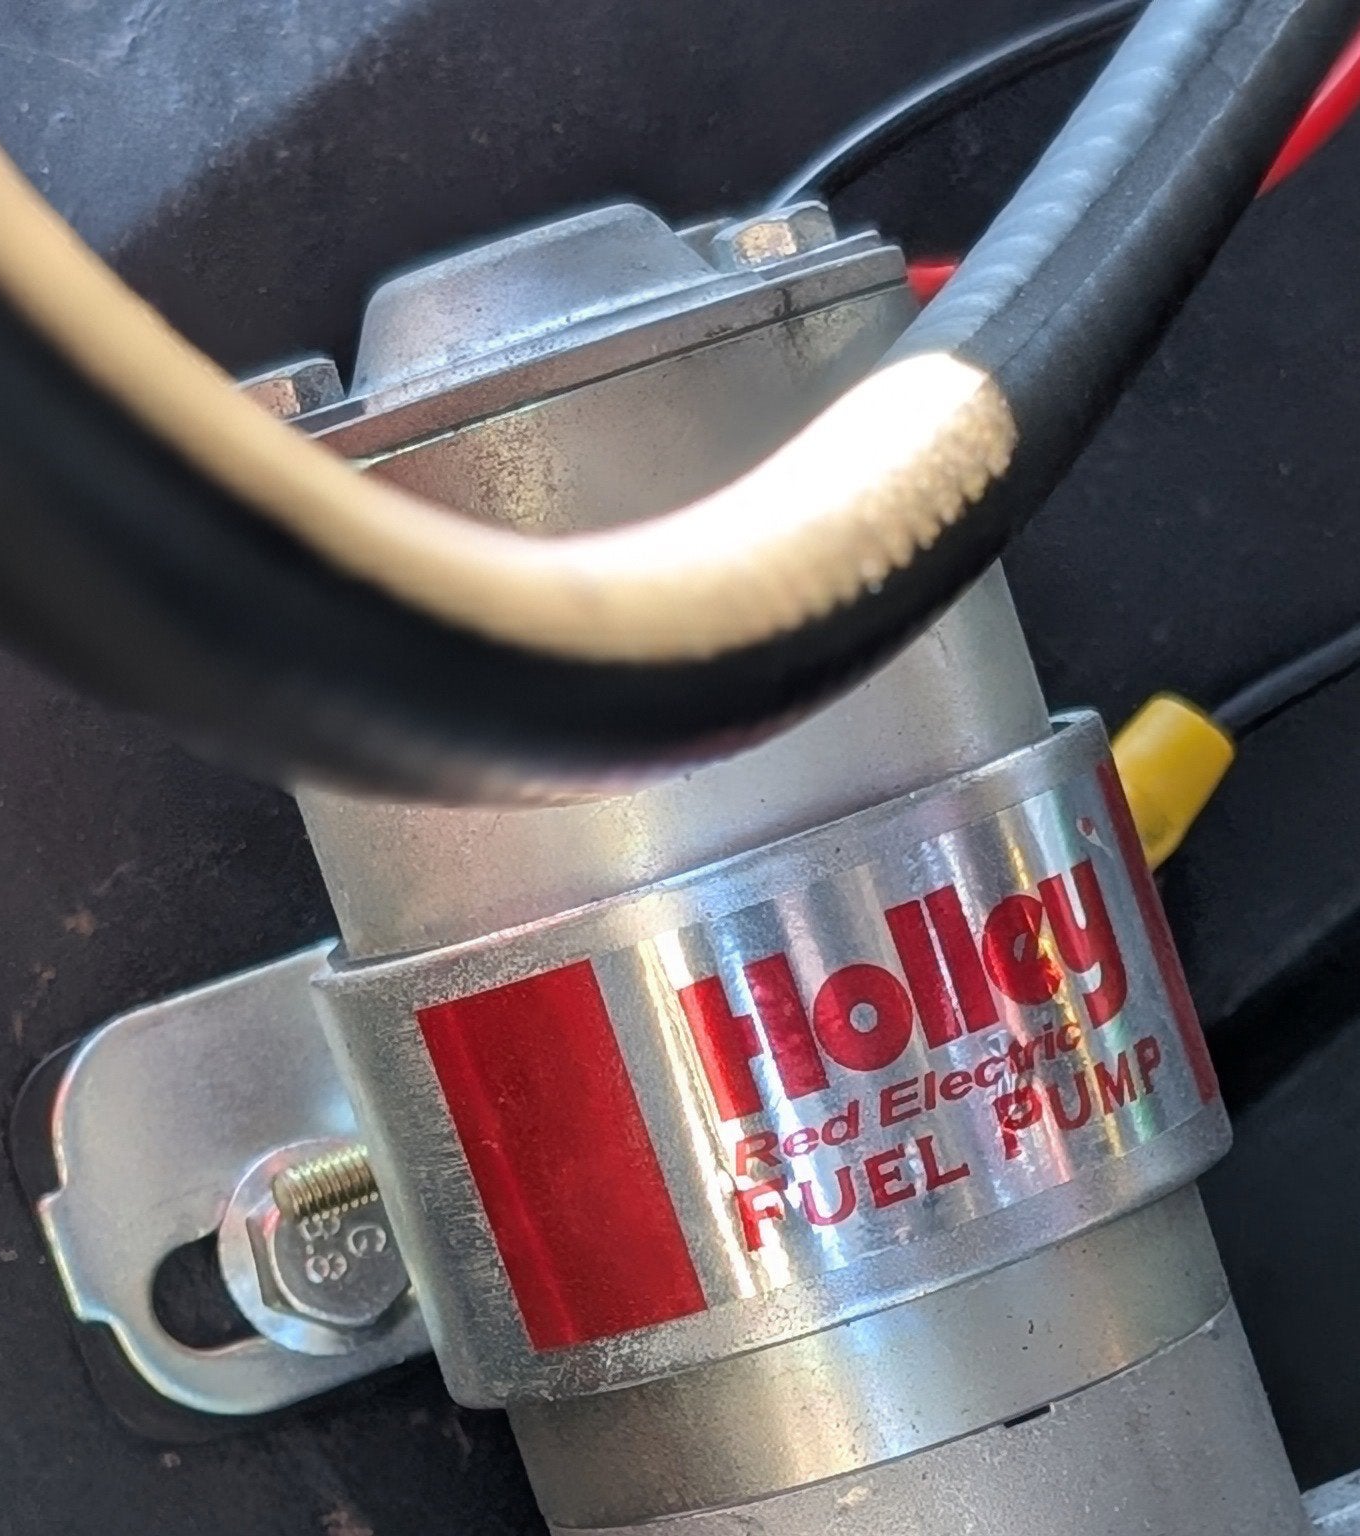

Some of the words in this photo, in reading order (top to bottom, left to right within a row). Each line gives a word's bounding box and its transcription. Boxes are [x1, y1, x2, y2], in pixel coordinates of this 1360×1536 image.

[679, 860, 1128, 1122] Holley
[736, 1099, 859, 1176] Red
[879, 1022, 1081, 1127] Electric
[735, 1134, 971, 1252] FUEL
[992, 1035, 1161, 1160] PUMP
